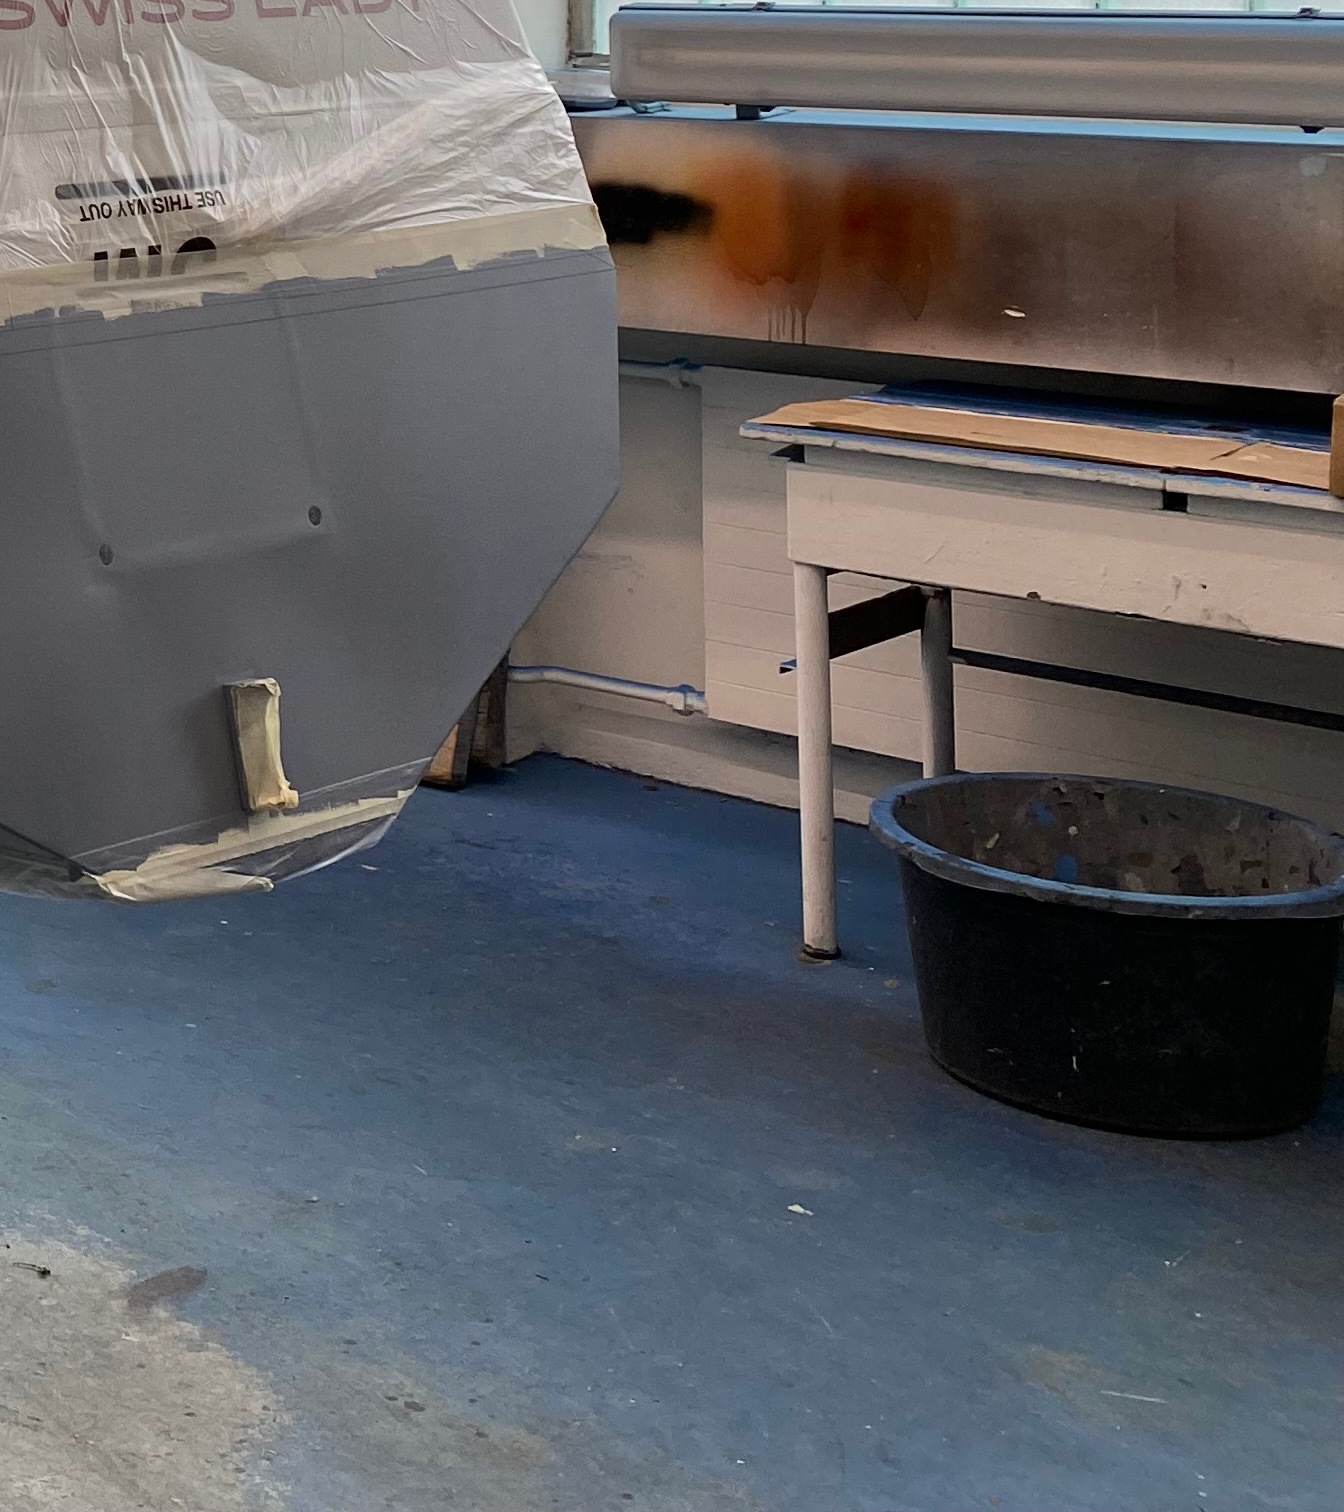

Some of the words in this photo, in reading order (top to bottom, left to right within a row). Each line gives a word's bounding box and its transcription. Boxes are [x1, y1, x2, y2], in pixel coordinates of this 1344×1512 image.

[118, 197, 153, 218] WAY
[151, 193, 193, 214] THIS
[195, 190, 226, 208] USE
[79, 202, 112, 222] OUT
